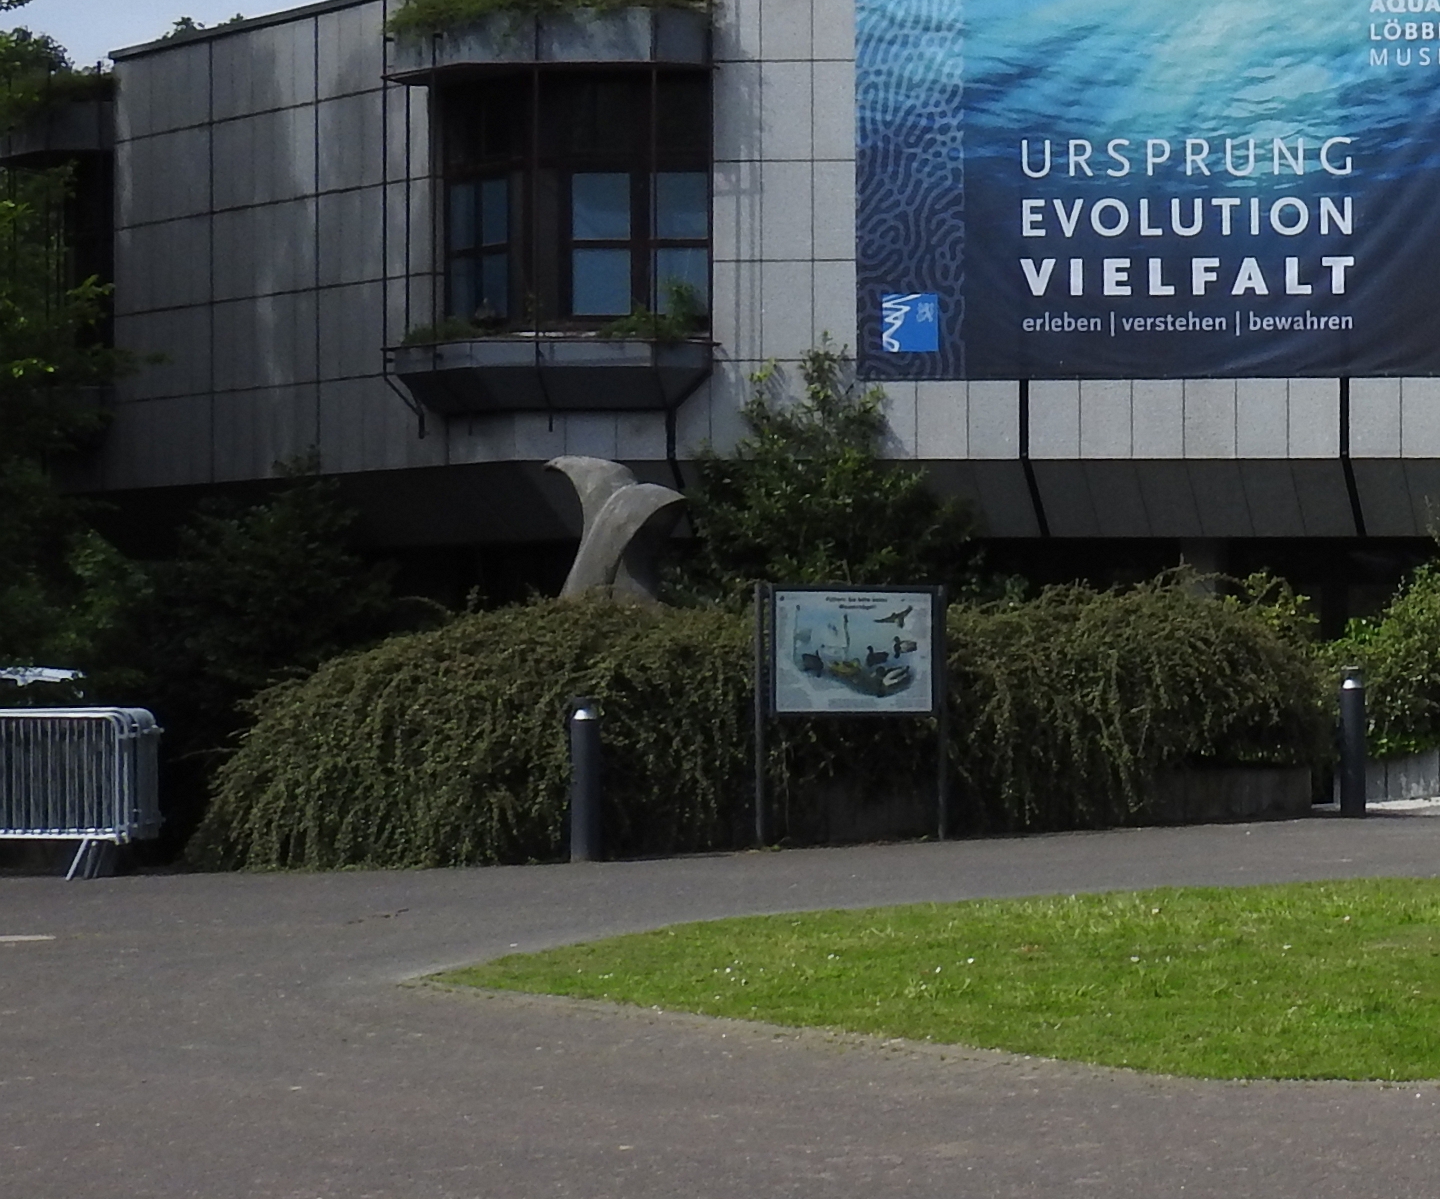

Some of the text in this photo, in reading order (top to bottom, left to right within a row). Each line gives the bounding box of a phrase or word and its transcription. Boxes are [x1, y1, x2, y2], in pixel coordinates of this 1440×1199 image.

[1020, 136, 1354, 178] URSPRUNG
[1020, 196, 1354, 238] EVOLUTION
[1020, 256, 1355, 297] VIELFALT
[1022, 311, 1102, 332] erleben
[1122, 311, 1227, 331] verstehen
[1249, 310, 1353, 331] bewahren
